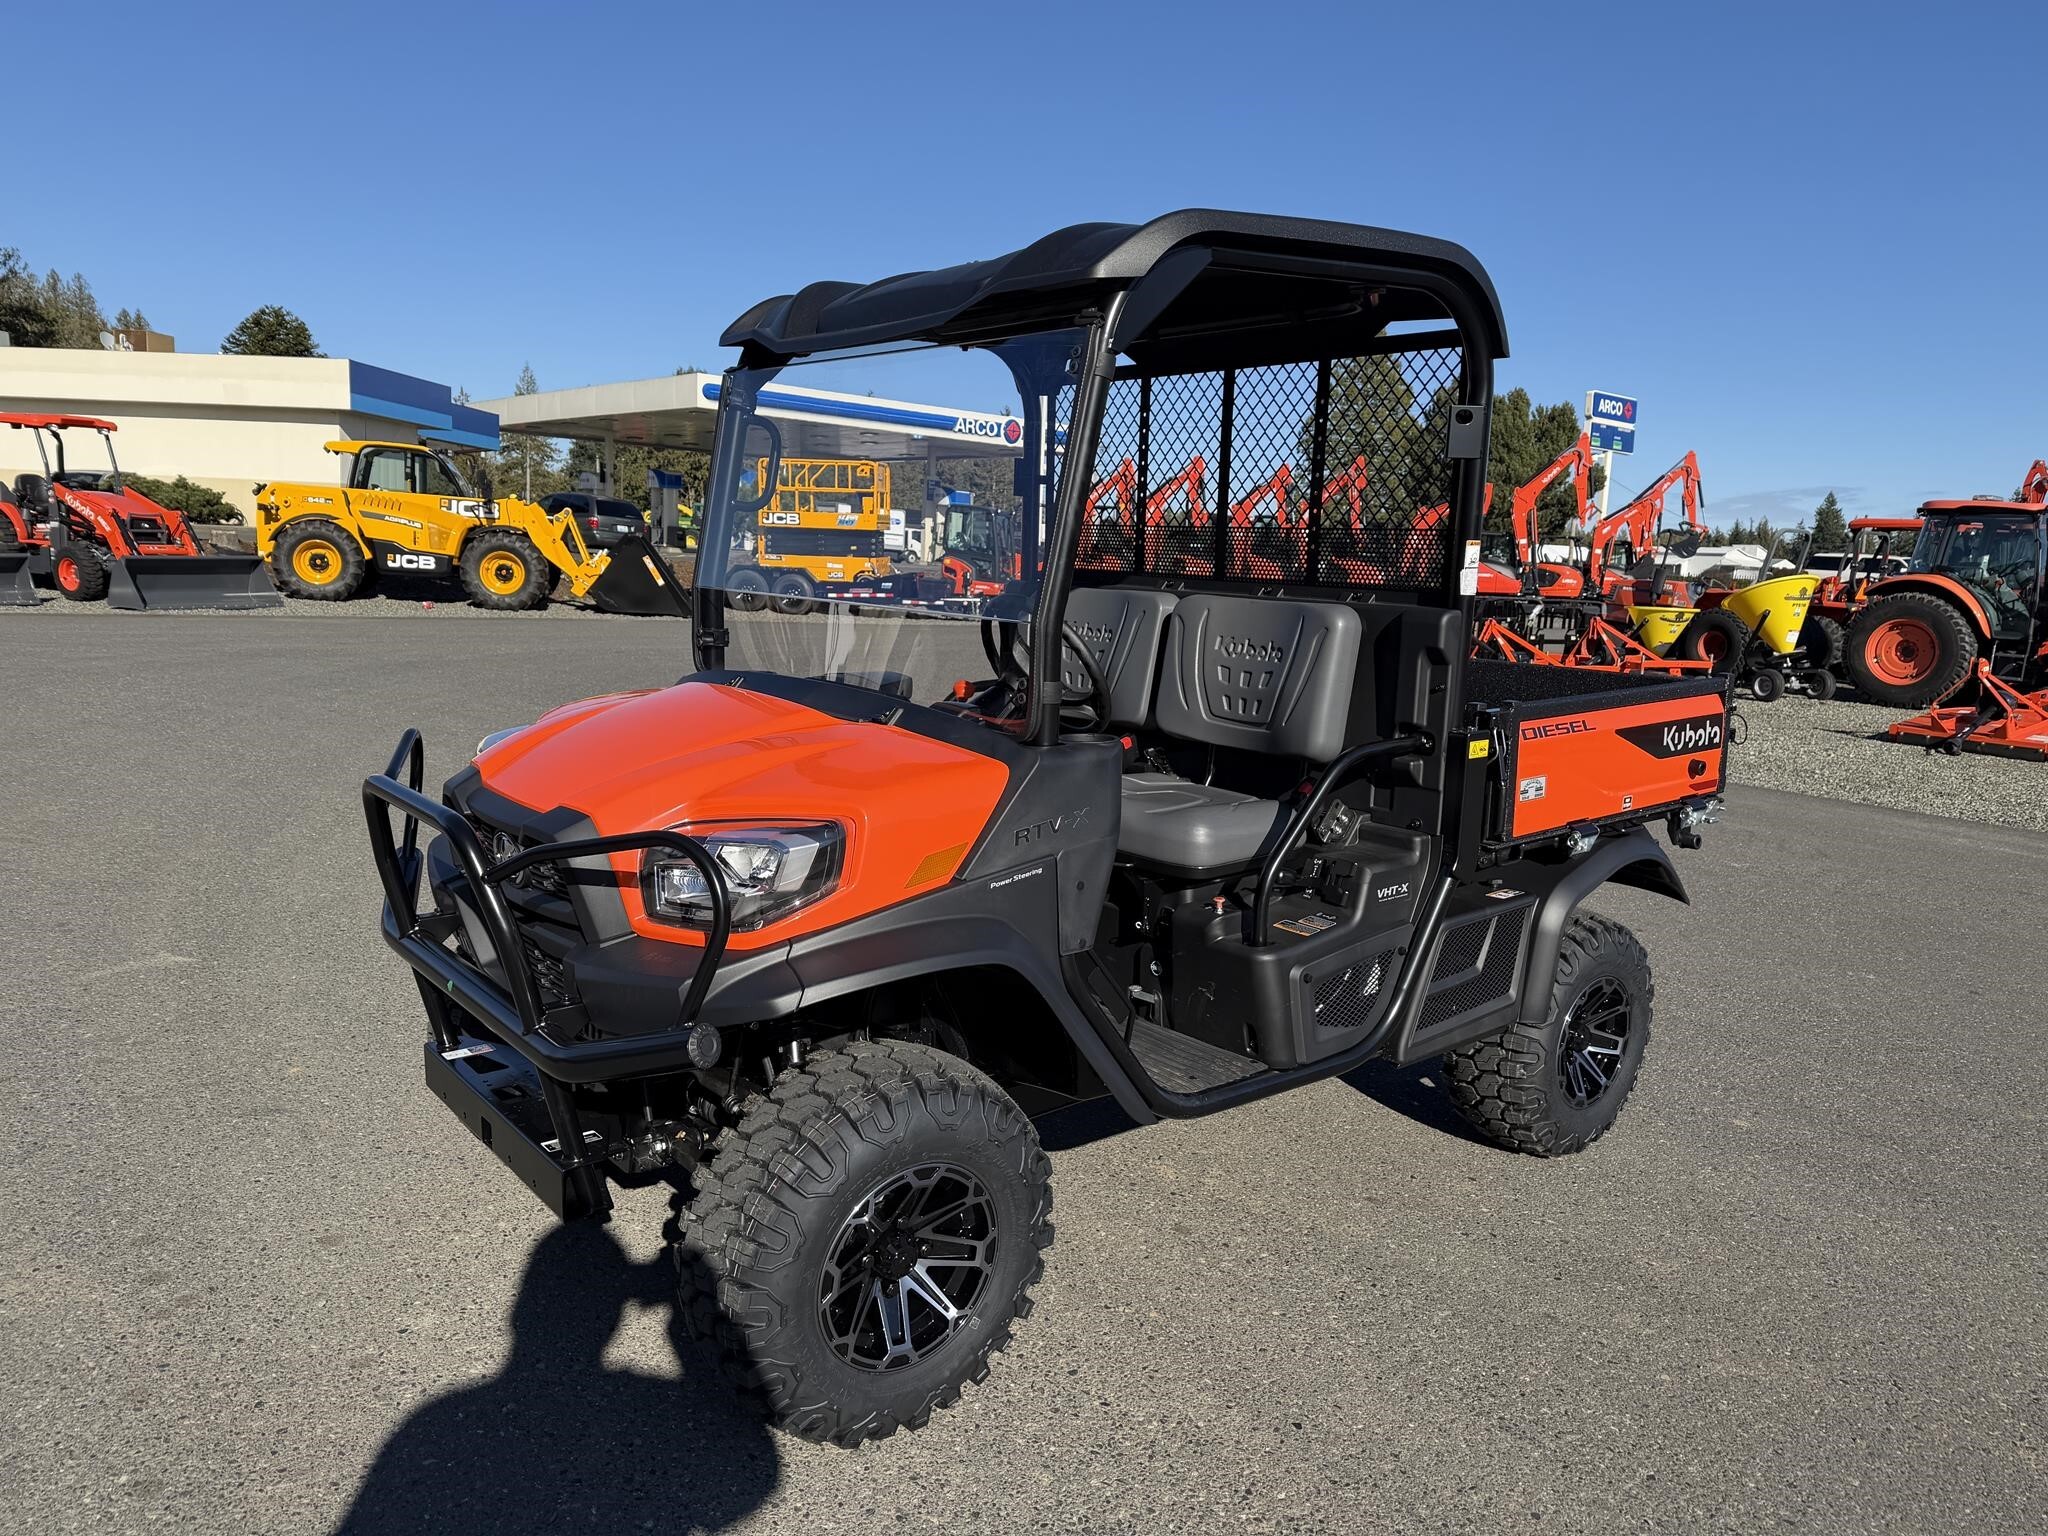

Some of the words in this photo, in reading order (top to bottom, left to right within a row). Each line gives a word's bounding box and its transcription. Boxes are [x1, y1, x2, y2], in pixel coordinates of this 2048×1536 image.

[1598, 398, 1623, 416] ARCO
[953, 417, 998, 437] ARCO
[64, 492, 95, 521] Kubota
[440, 499, 500, 519] JCB
[762, 513, 800, 525] JCB
[387, 554, 436, 570] JCB
[1214, 635, 1283, 663] Kubota
[1521, 719, 1597, 741] DIESEL
[1663, 720, 1720, 751] Kubota
[1014, 806, 1089, 846] RTV-X
[990, 877, 1013, 889] Power
[1012, 867, 1043, 882] Steering
[1377, 882, 1409, 899] VHT-X
